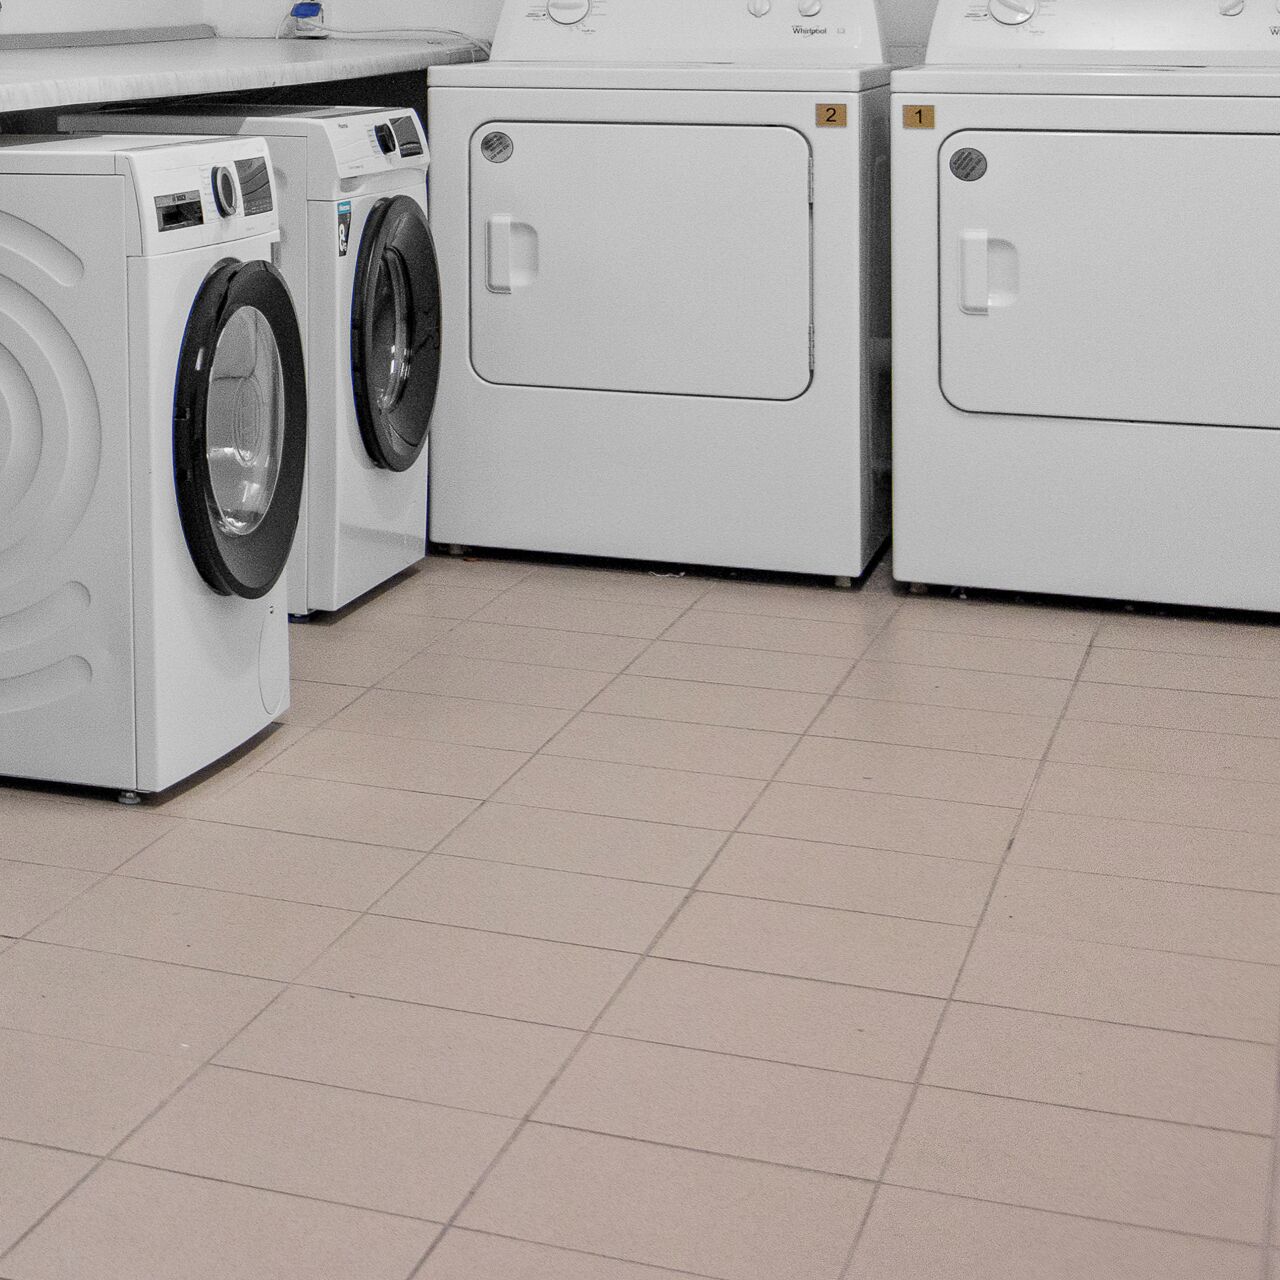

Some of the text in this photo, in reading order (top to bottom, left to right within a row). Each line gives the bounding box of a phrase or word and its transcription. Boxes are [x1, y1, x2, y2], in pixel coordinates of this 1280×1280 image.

[792, 26, 827, 36] Whirlpool
[825, 107, 837, 123] 2
[914, 108, 923, 124] 1
